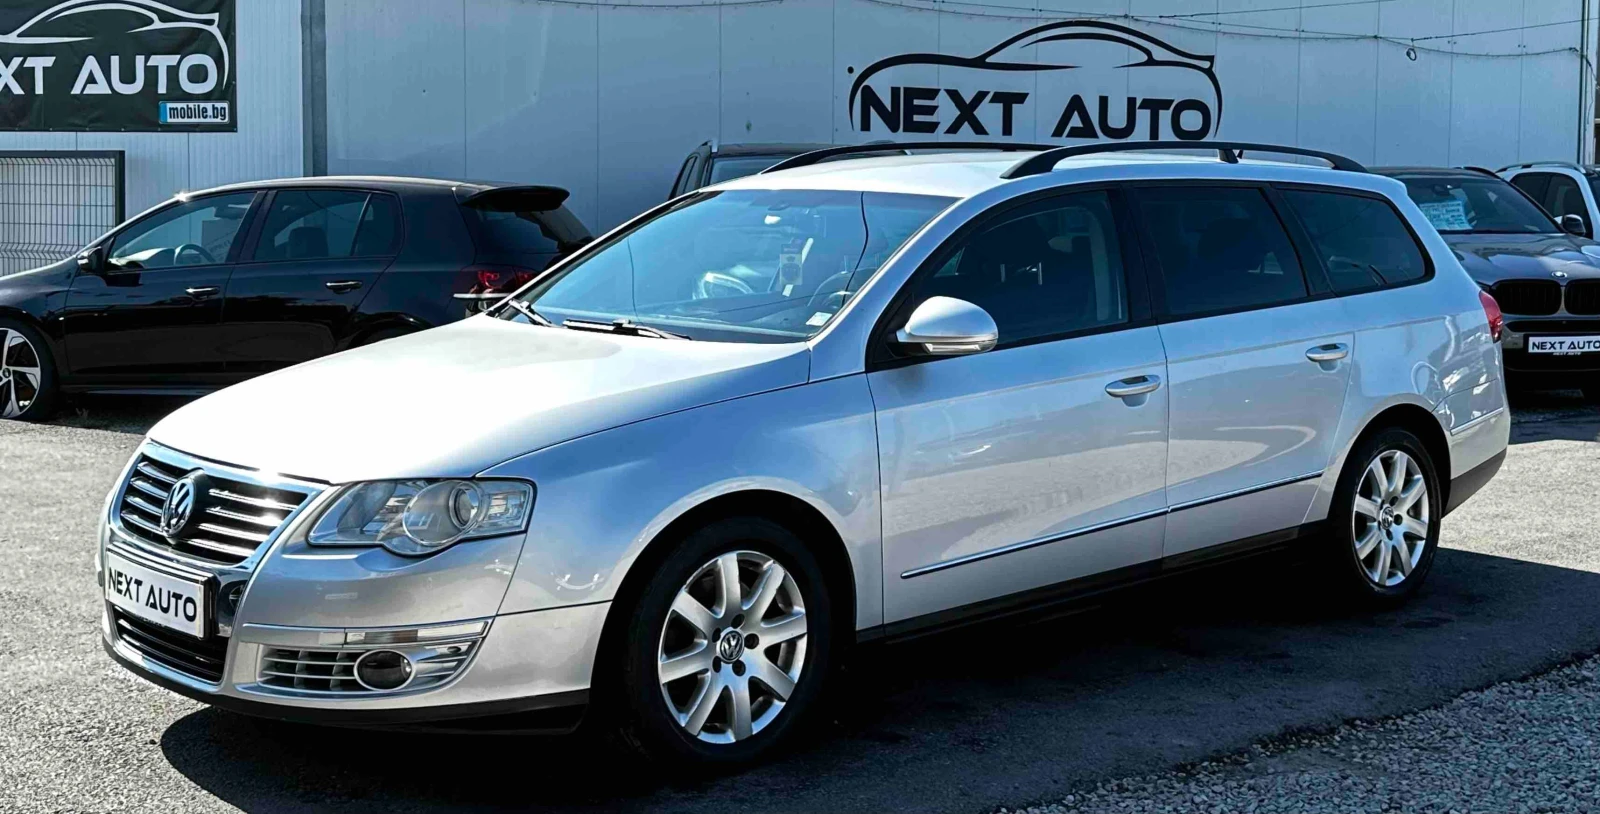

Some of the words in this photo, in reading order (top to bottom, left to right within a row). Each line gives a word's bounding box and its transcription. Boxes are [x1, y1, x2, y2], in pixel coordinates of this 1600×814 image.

[71, 53, 218, 95] AUTO
[168, 104, 227, 121] mobile.bg
[860, 84, 1030, 137] NEXT
[1051, 93, 1212, 141] AUTO
[1531, 341, 1566, 351] NEXT
[1567, 340, 1600, 350] AUTO
[108, 567, 143, 603] NEXT
[145, 584, 198, 622] AUTO
